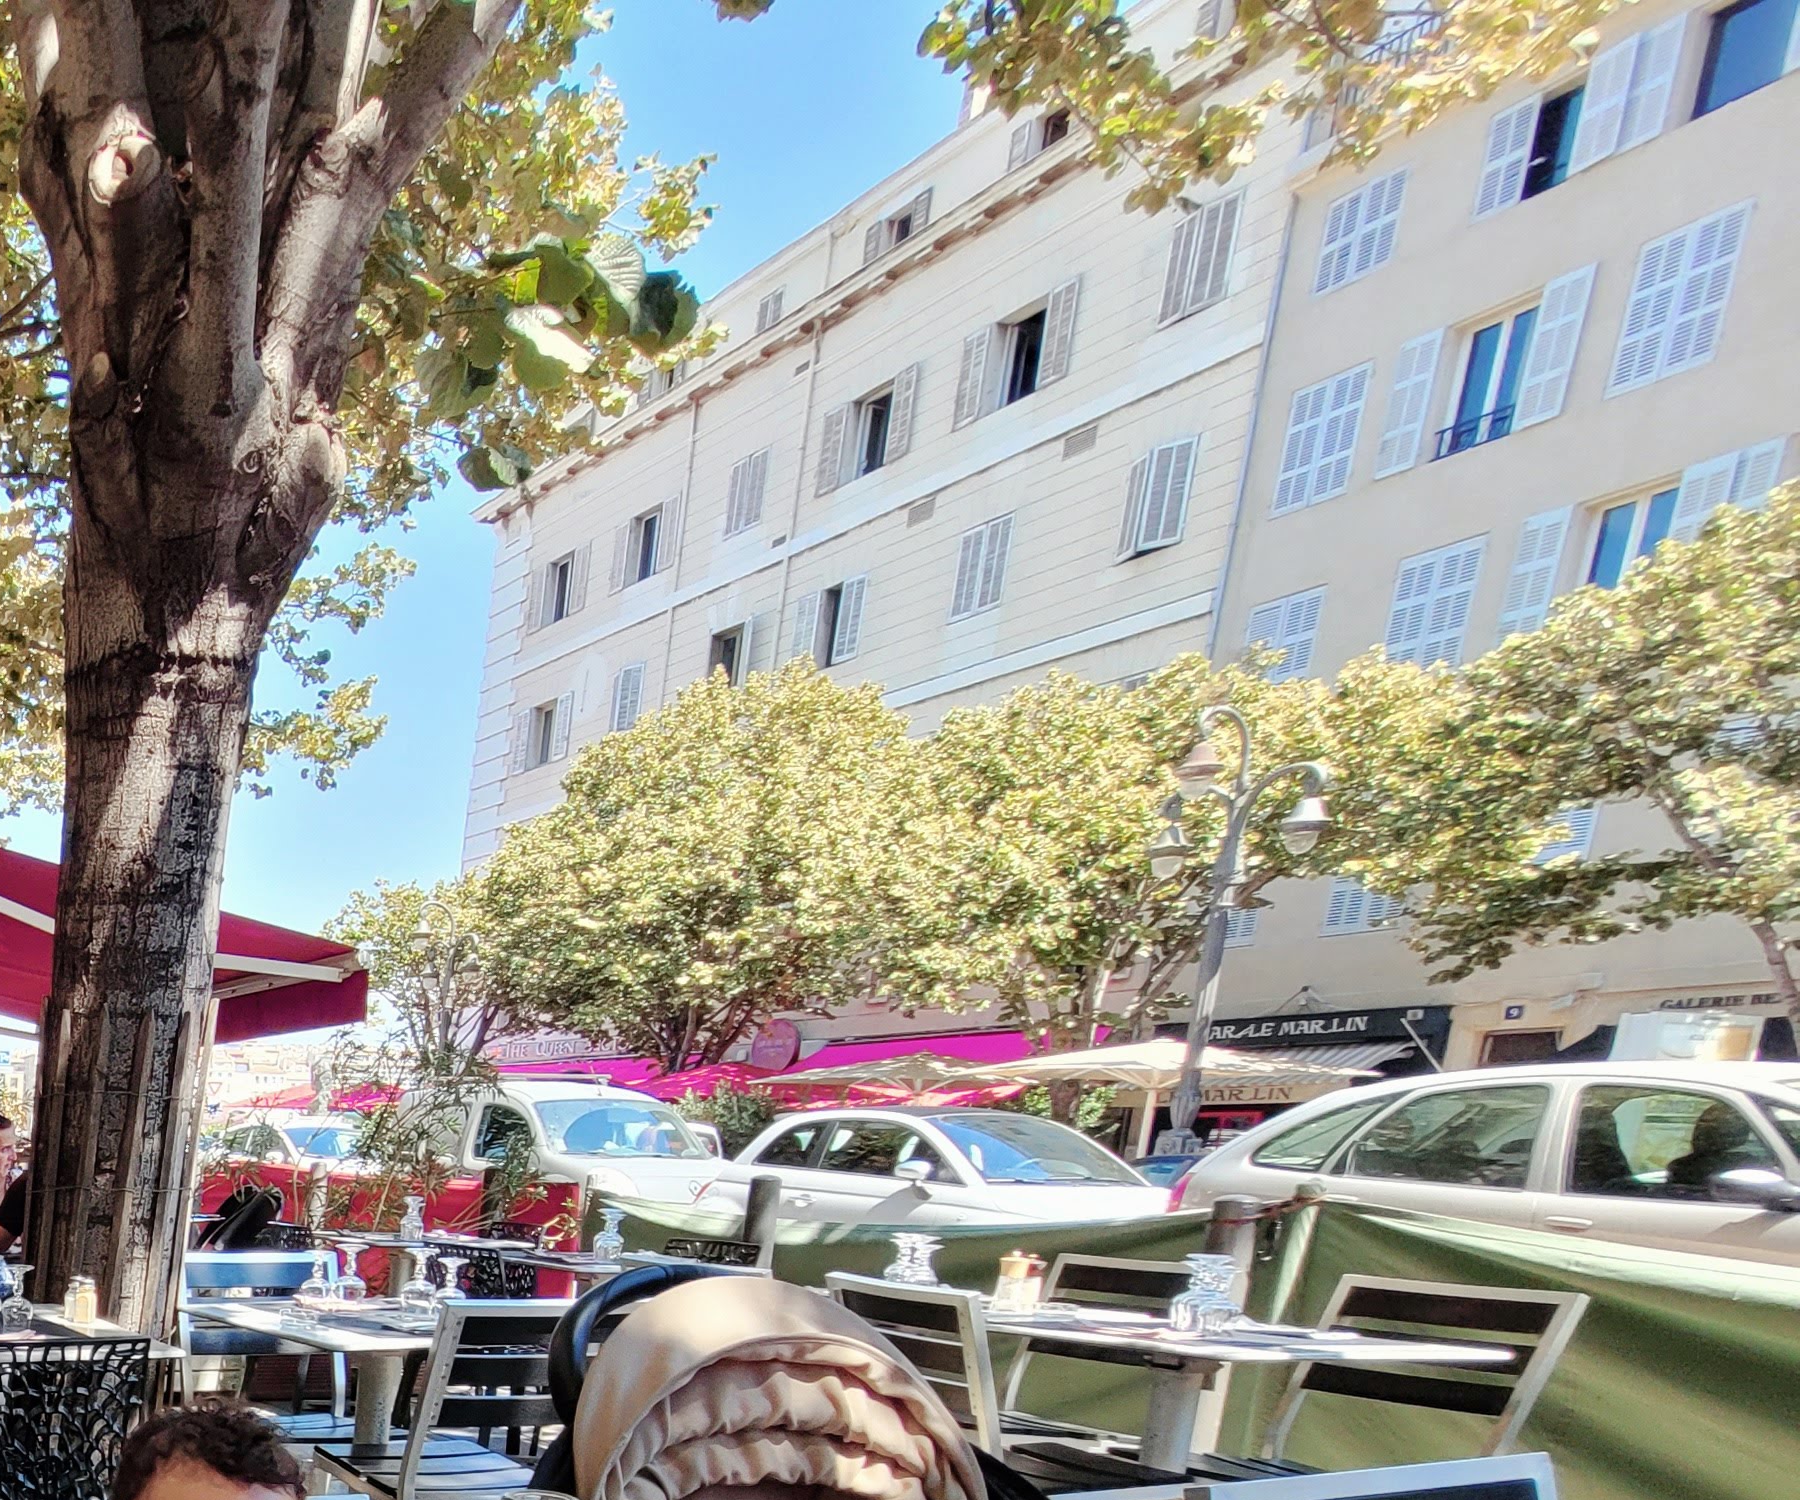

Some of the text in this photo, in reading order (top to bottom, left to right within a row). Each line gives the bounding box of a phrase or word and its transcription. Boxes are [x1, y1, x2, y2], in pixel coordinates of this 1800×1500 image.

[1660, 994, 1745, 1010] GALERIE
[1277, 1016, 1369, 1037] MARLIN
[505, 1043, 529, 1059] THE
[536, 1040, 578, 1057] QUEEN
